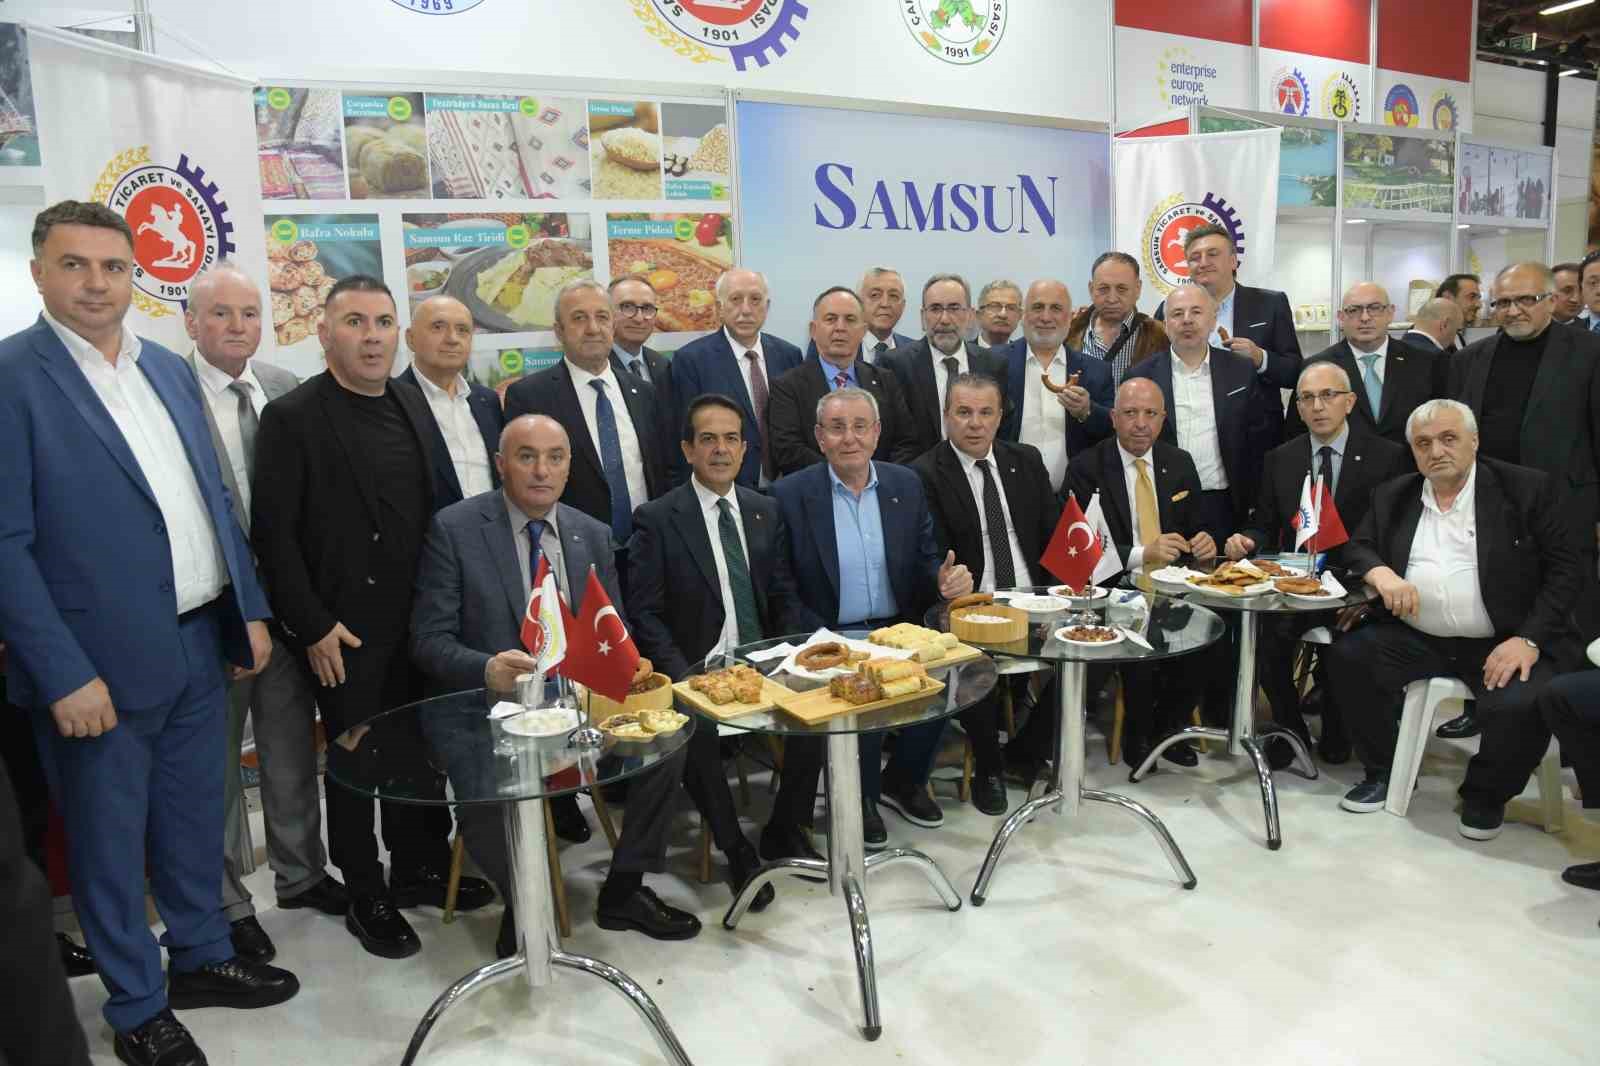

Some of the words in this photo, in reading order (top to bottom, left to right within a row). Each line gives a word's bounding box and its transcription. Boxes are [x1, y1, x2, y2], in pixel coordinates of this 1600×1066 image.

[702, 27, 740, 41] 1901
[944, 46, 970, 58] 1991
[1170, 63, 1217, 80] enterprise
[1171, 79, 1205, 95] europe
[1171, 94, 1209, 105] network
[115, 172, 164, 208] TİCARET
[170, 177, 182, 189] ve
[185, 188, 216, 239] SANAYİ
[814, 162, 1059, 237] SAMSUN
[301, 226, 330, 240] Bafra
[612, 223, 641, 236] Terme
[645, 223, 674, 235] Pidesi
[409, 232, 450, 243] Samsun
[454, 231, 473, 242] Kaz
[160, 285, 187, 296] 1901
